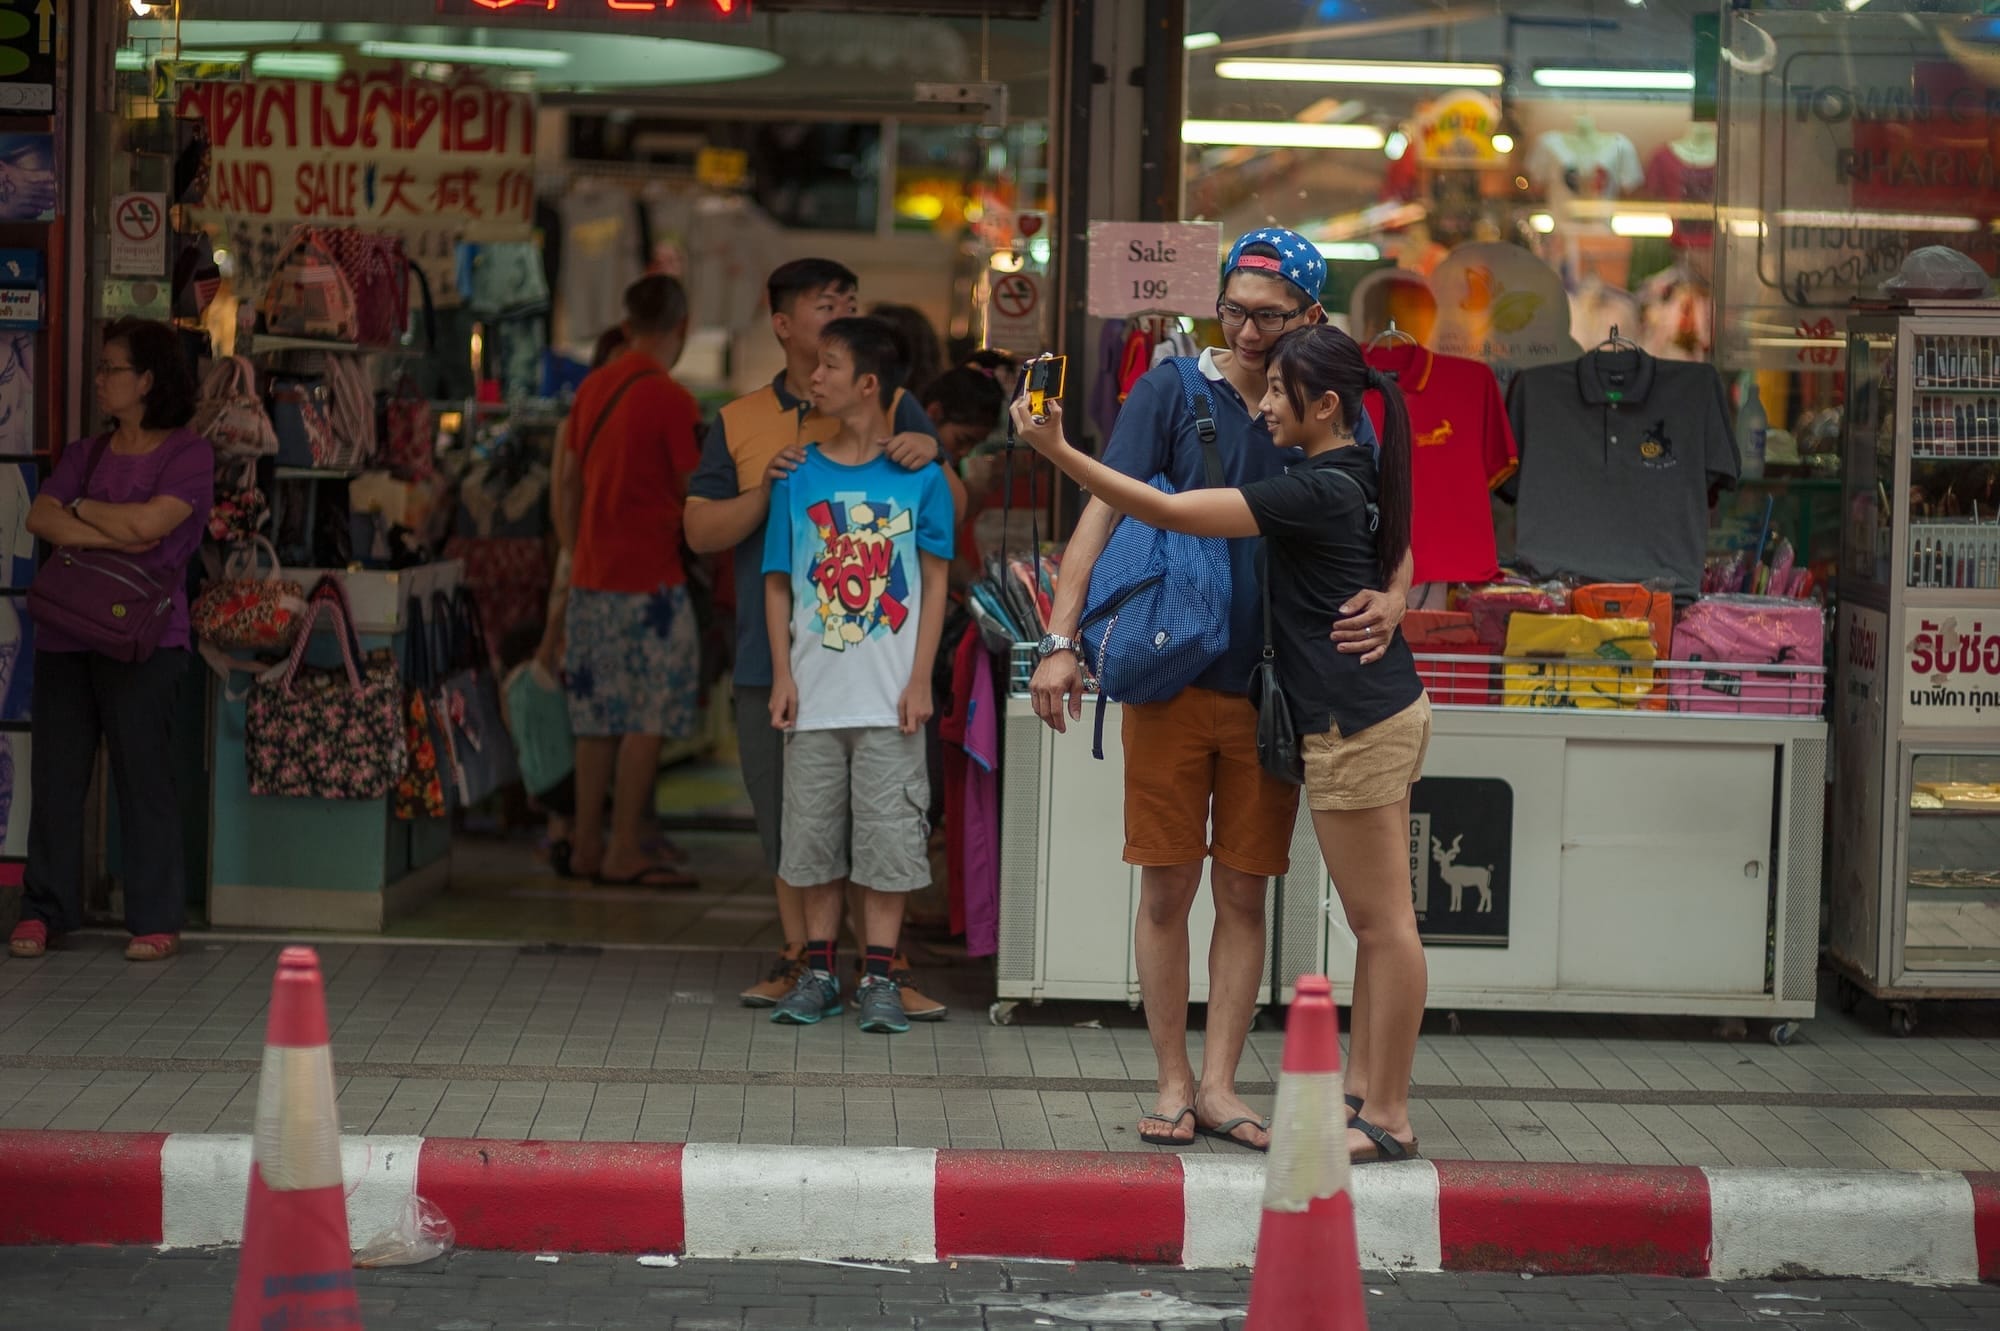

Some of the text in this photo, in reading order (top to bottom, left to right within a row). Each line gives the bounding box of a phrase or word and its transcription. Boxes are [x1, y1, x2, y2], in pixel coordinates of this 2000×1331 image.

[1789, 85, 1930, 124] TOWN
[1836, 148, 2000, 185] PHARM
[294, 160, 357, 216] SALE
[1127, 240, 1177, 263] Sale
[1131, 280, 1168, 299] 199
[813, 538, 894, 613] POW
